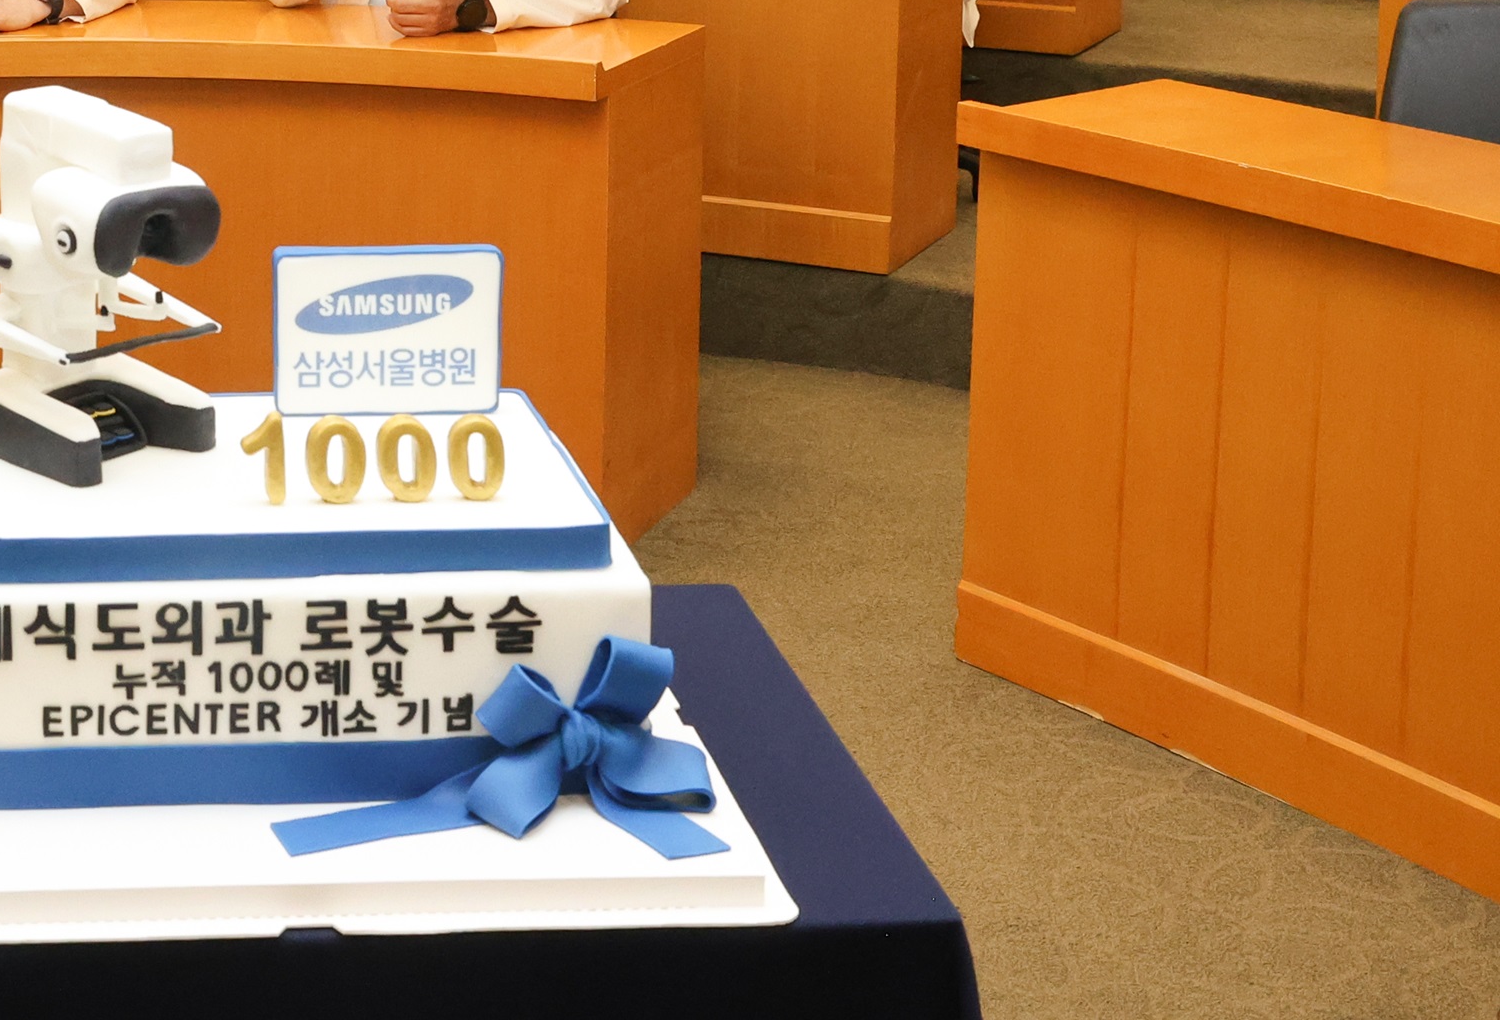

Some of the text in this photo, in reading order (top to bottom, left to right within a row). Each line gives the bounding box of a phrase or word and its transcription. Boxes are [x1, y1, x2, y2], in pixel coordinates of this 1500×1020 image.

[318, 292, 451, 318] SAMSUNG
[293, 347, 477, 389] 삼성서울병원
[240, 411, 506, 505] 1000
[300, 595, 543, 657] 로봇수술
[112, 660, 405, 701] 누적 1000례 및
[42, 693, 475, 738] EPICENTER 개소 기념
